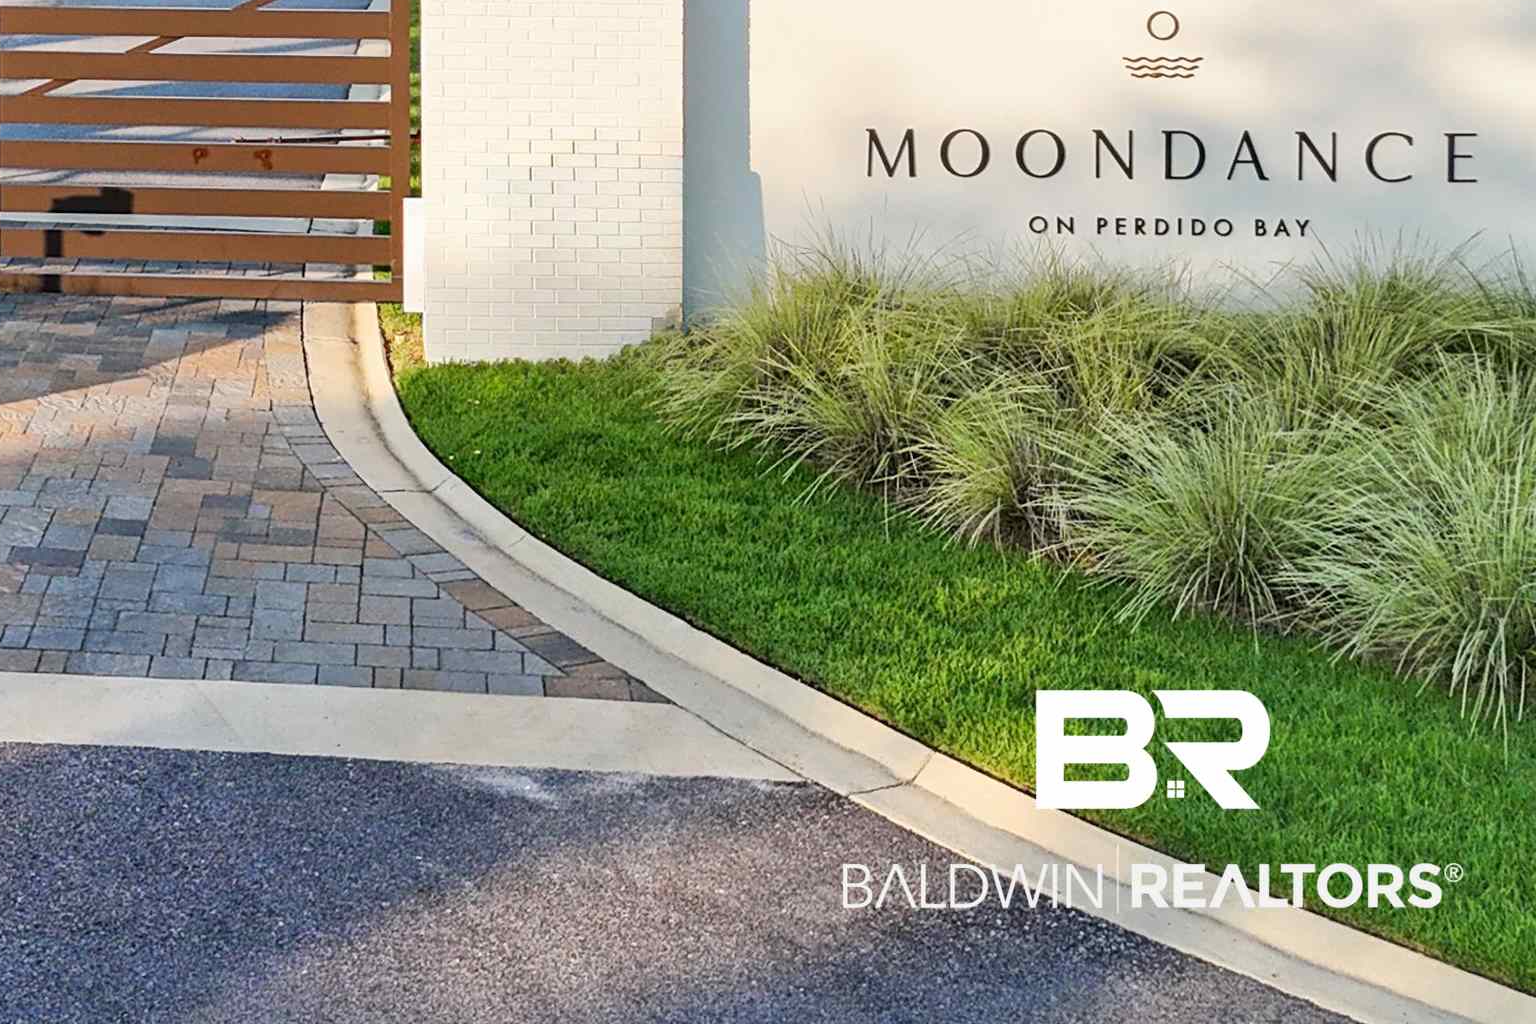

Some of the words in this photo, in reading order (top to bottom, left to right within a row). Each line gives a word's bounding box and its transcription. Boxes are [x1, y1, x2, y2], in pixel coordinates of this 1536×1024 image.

[865, 127, 1479, 184] MOONDANCE
[1028, 215, 1076, 235] ON
[1096, 216, 1234, 237] PERDIDO
[1254, 218, 1312, 237] BAY
